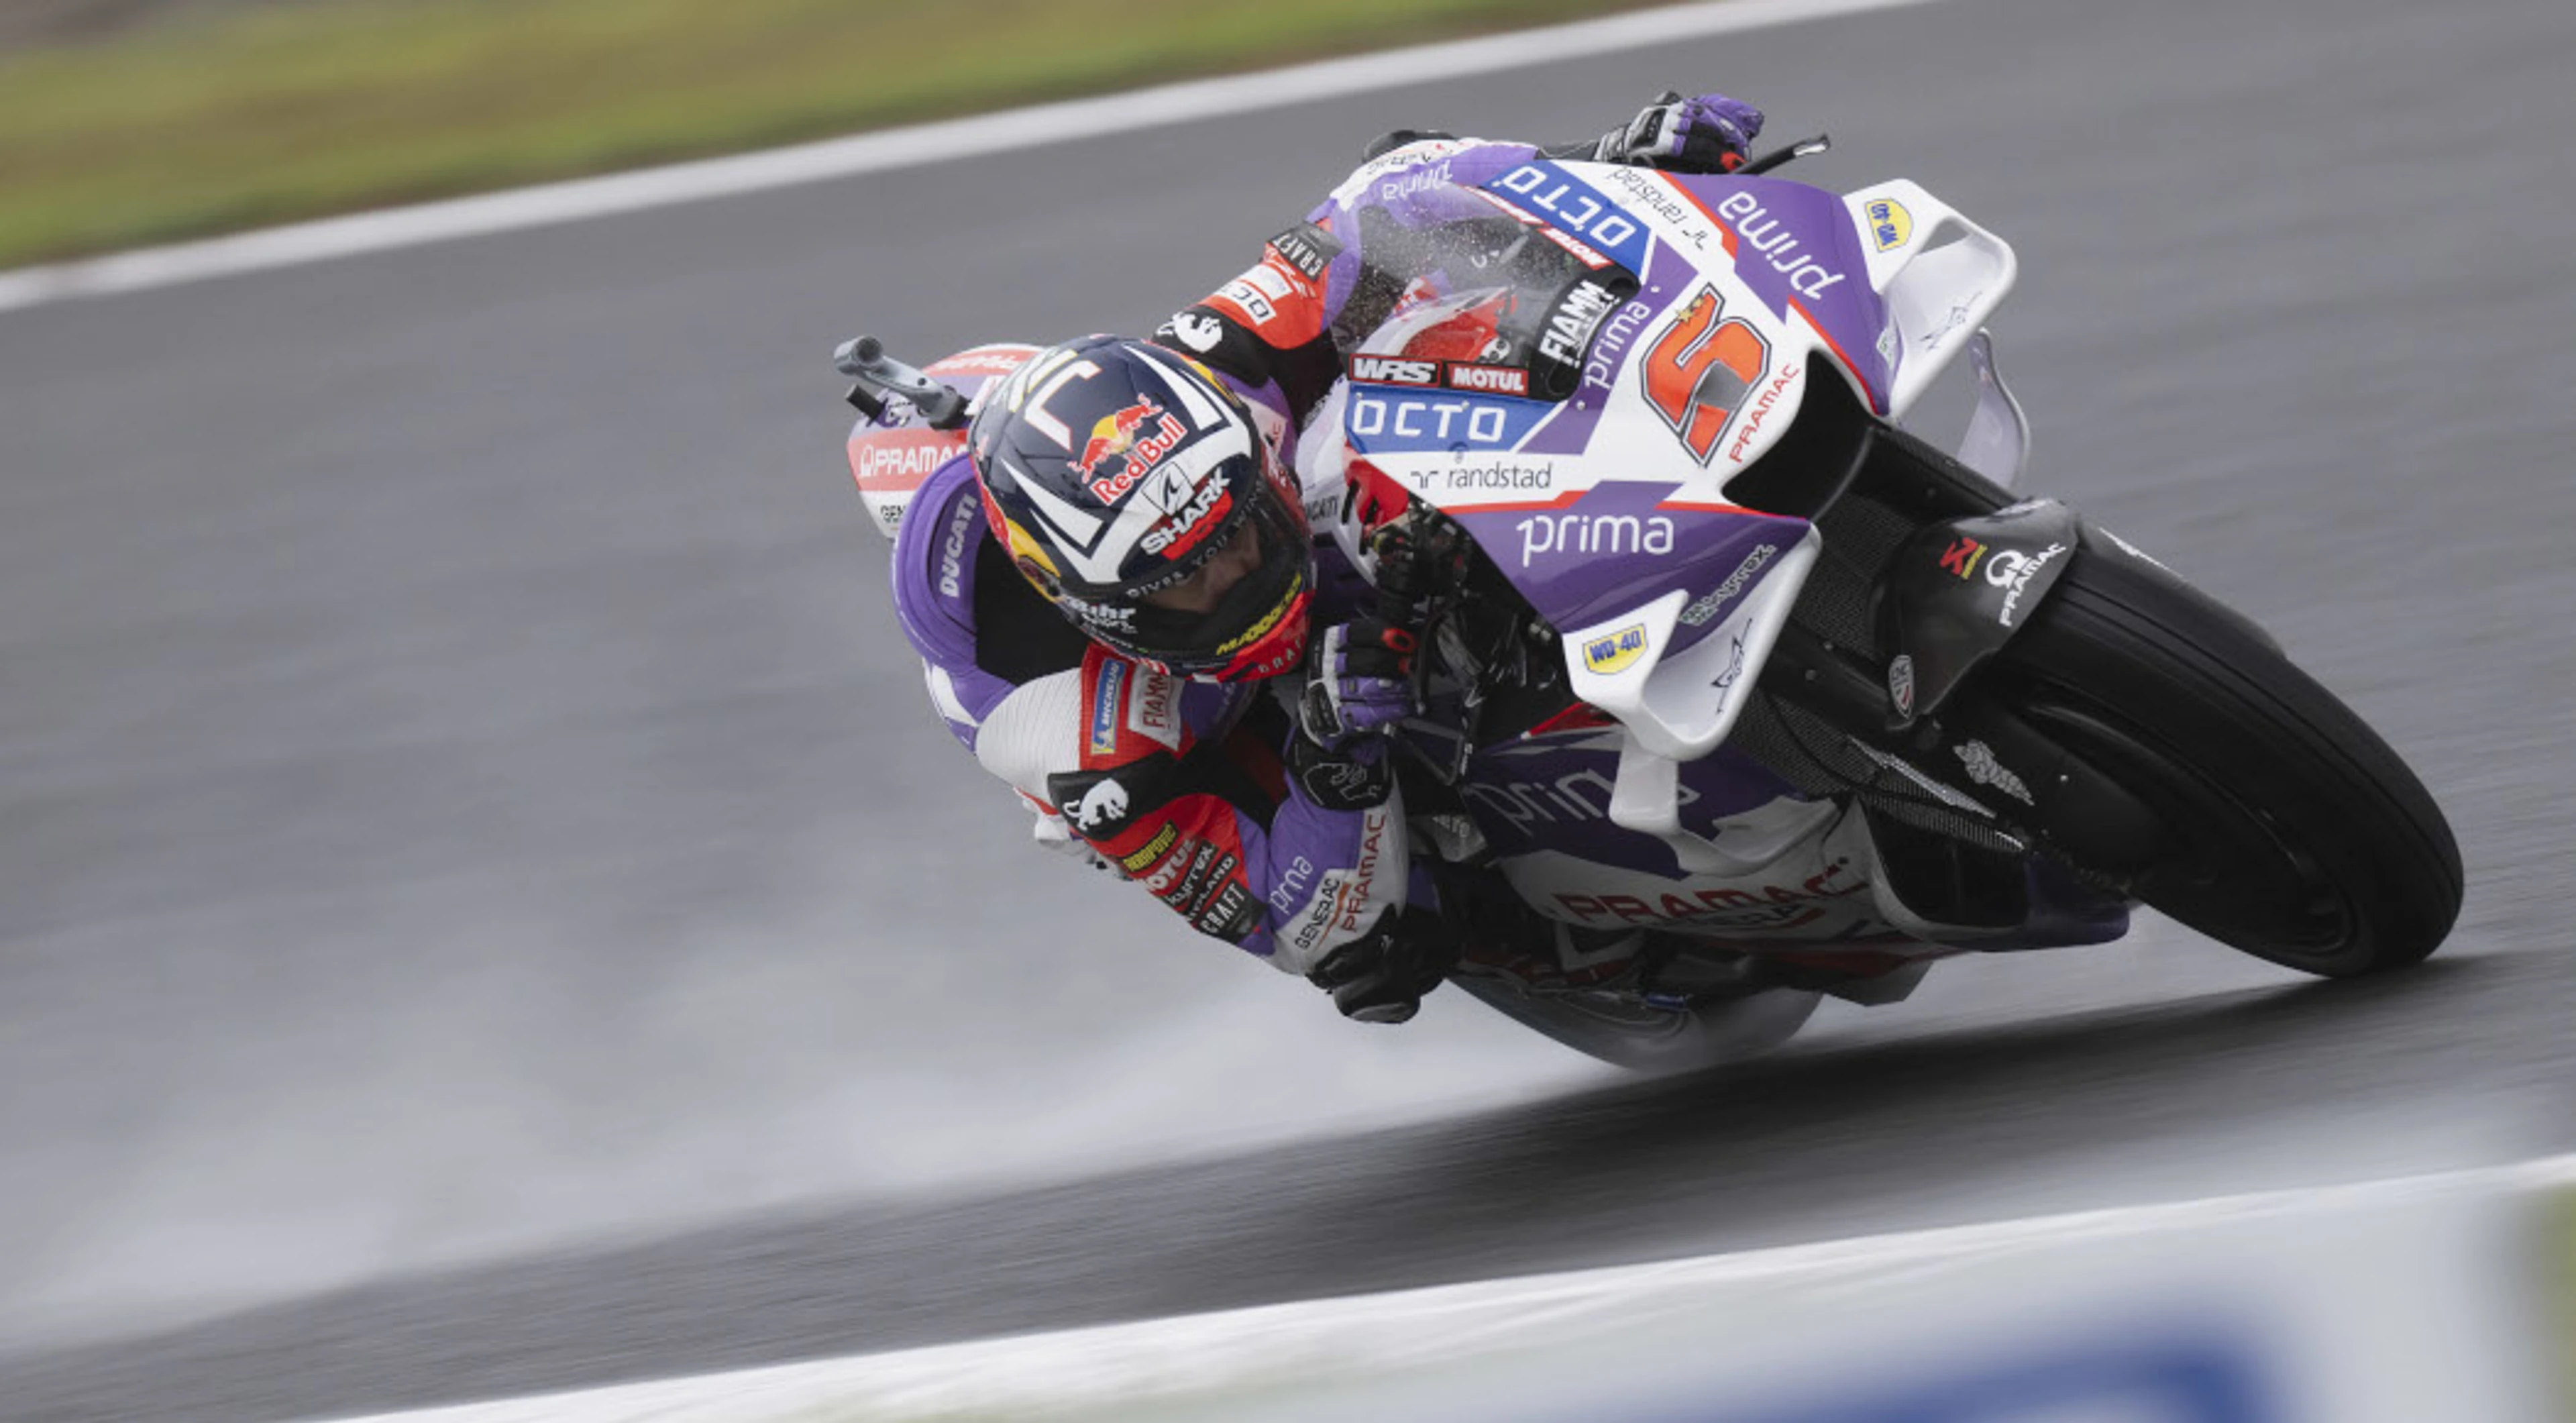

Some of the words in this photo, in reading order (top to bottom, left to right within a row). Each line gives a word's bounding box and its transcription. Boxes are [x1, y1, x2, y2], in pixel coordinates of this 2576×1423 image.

[1501, 165, 1637, 248] OCTO
[1719, 191, 1845, 300] prima
[1272, 232, 1324, 276] CRAFT
[1539, 279, 1615, 366] FIAMM
[1585, 301, 1651, 390] prima
[1451, 366, 1525, 392] MOTUL
[1639, 282, 1771, 469] 5
[1729, 364, 1800, 463] PRAMAC
[1089, 444, 1148, 506] Red
[1136, 411, 1188, 466] Bull
[1352, 399, 1507, 443] OCTO
[1140, 467, 1232, 556] SHARK
[1447, 462, 1551, 489] randstad
[940, 493, 977, 598] DUCATI
[1516, 515, 1674, 568] prima
[1999, 542, 2066, 627] PRAMAC
[1589, 630, 1642, 663] WD-40
[1199, 882, 1245, 933] CRAFT
[1295, 878, 1340, 950] GENERAC
[1340, 814, 1386, 933] PRAMAC
